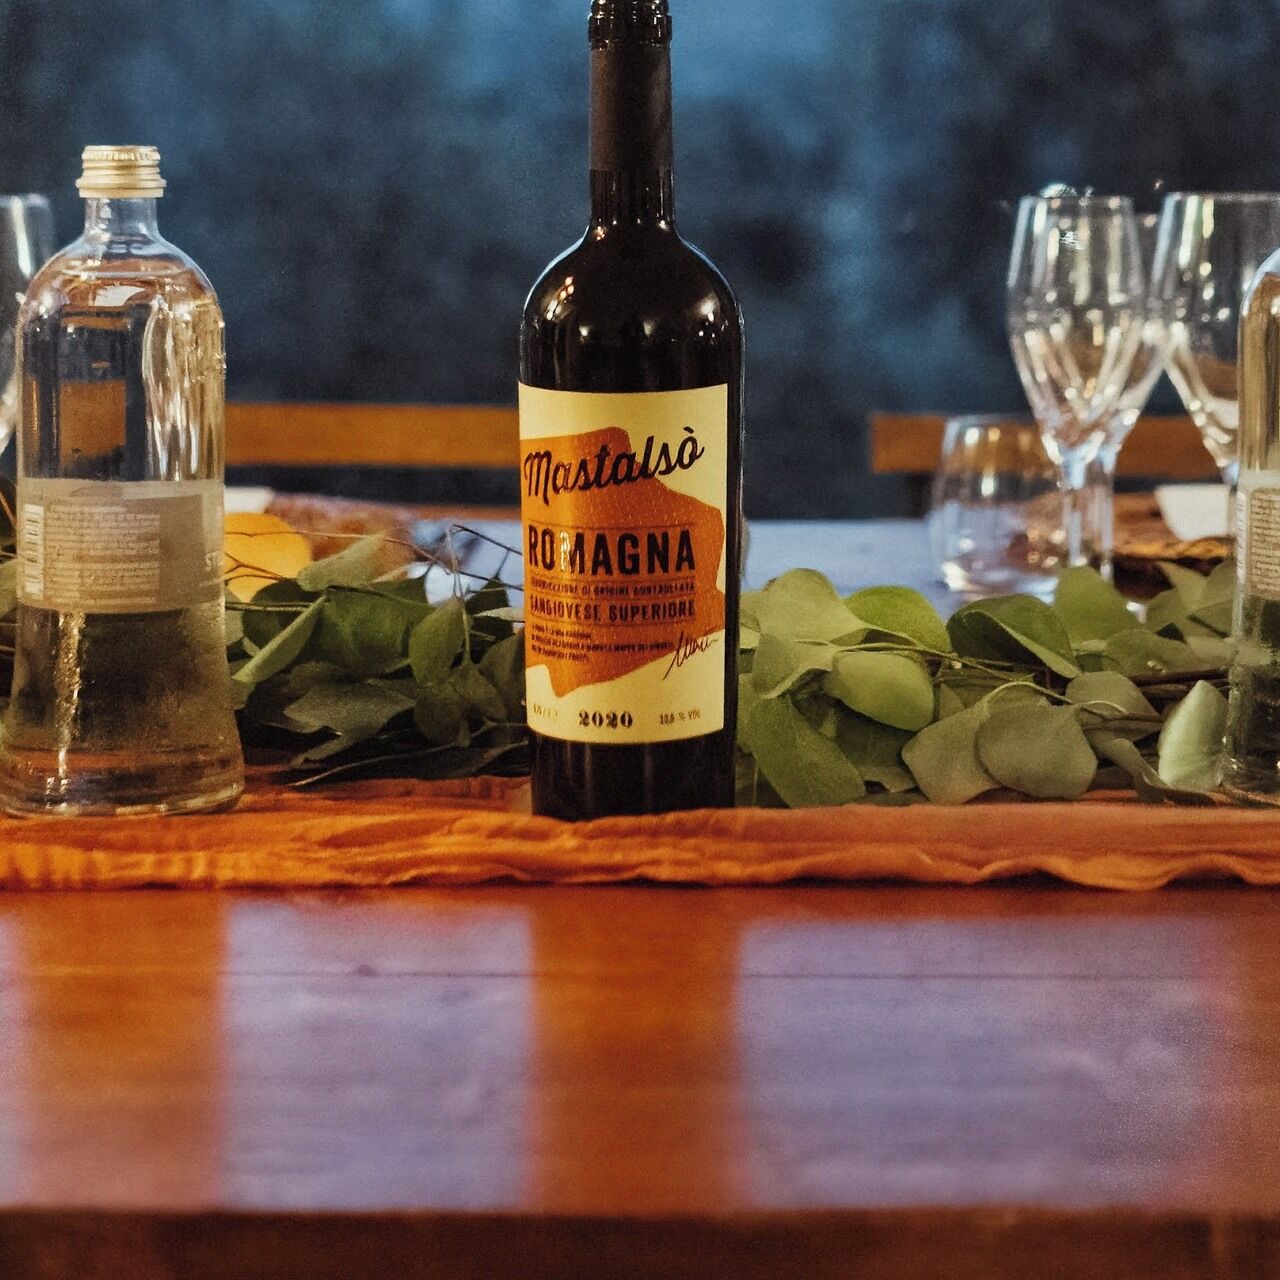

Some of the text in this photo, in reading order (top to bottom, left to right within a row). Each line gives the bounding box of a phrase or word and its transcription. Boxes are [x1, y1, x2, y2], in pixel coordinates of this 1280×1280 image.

[524, 426, 705, 506] Mastalsò
[528, 524, 696, 576] ROMAGNA
[530, 594, 695, 622] SANGIOVESE SUPERIORE
[578, 710, 633, 728] 2020
